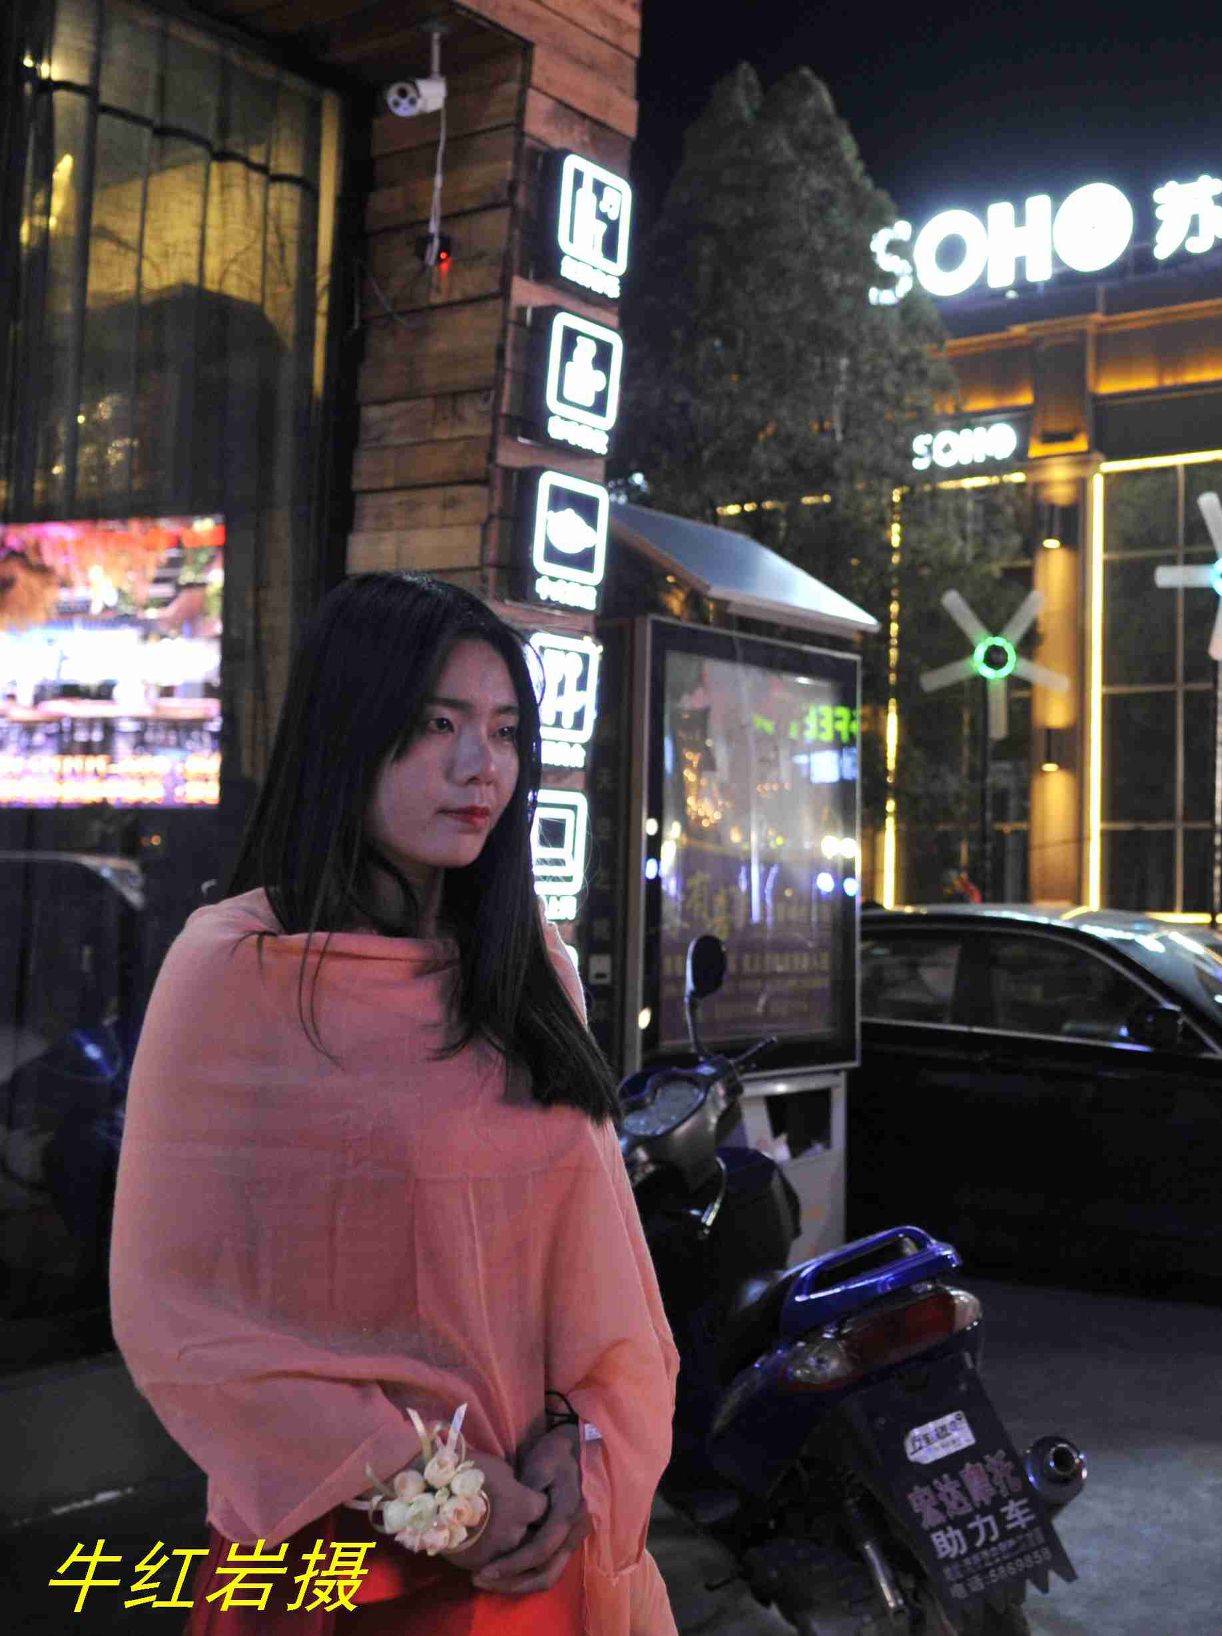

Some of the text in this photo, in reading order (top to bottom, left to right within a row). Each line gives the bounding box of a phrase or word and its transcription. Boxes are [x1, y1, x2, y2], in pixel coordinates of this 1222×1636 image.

[868, 182, 1134, 305] SOHO
[912, 422, 1018, 470] SOHO
[930, 1498, 1036, 1560] 助力车
